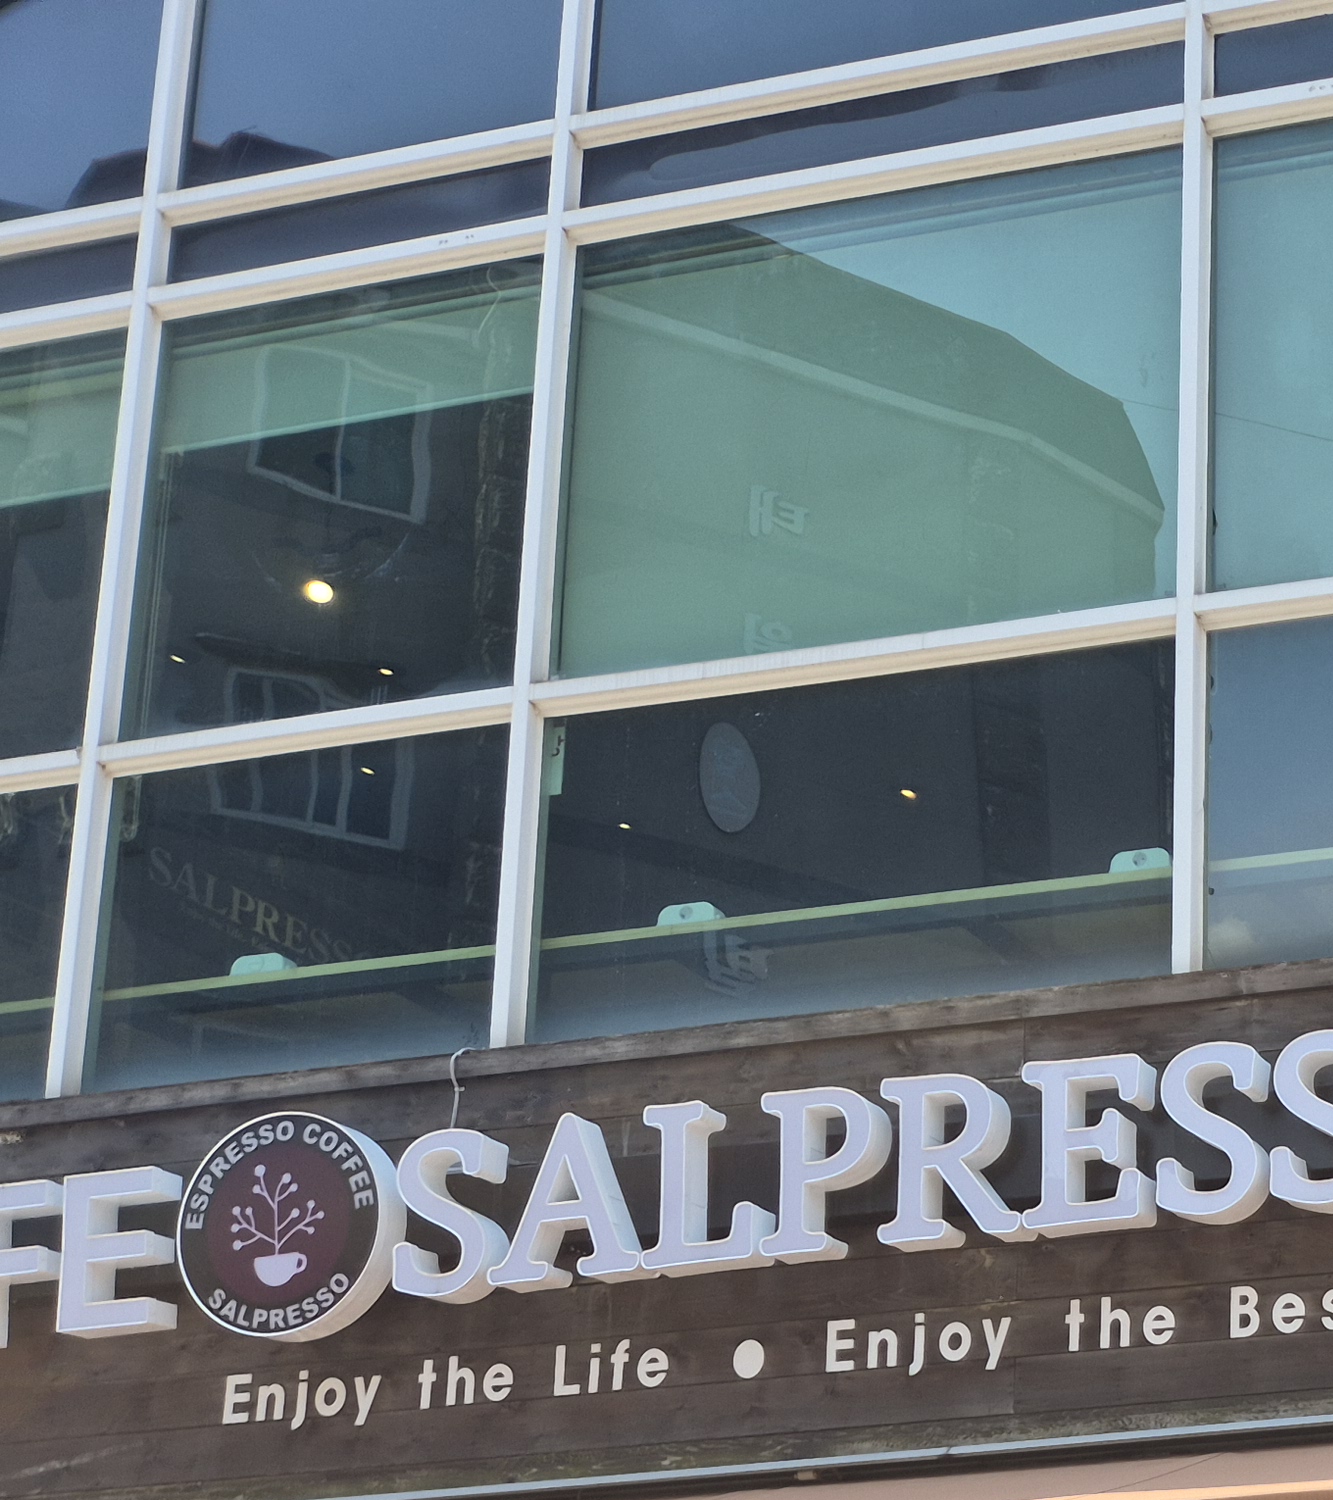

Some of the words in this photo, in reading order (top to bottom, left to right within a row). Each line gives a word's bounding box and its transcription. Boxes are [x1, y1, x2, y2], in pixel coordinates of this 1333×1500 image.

[185, 1120, 294, 1229] ESPRESSO
[303, 1123, 374, 1209] COFFEE
[208, 1273, 349, 1329] SALPRESSO
[221, 1368, 382, 1430] Enjoy
[418, 1354, 514, 1411] the
[553, 1340, 670, 1397] Life
[825, 1312, 1011, 1376] Enjoy
[1064, 1296, 1176, 1352] the
